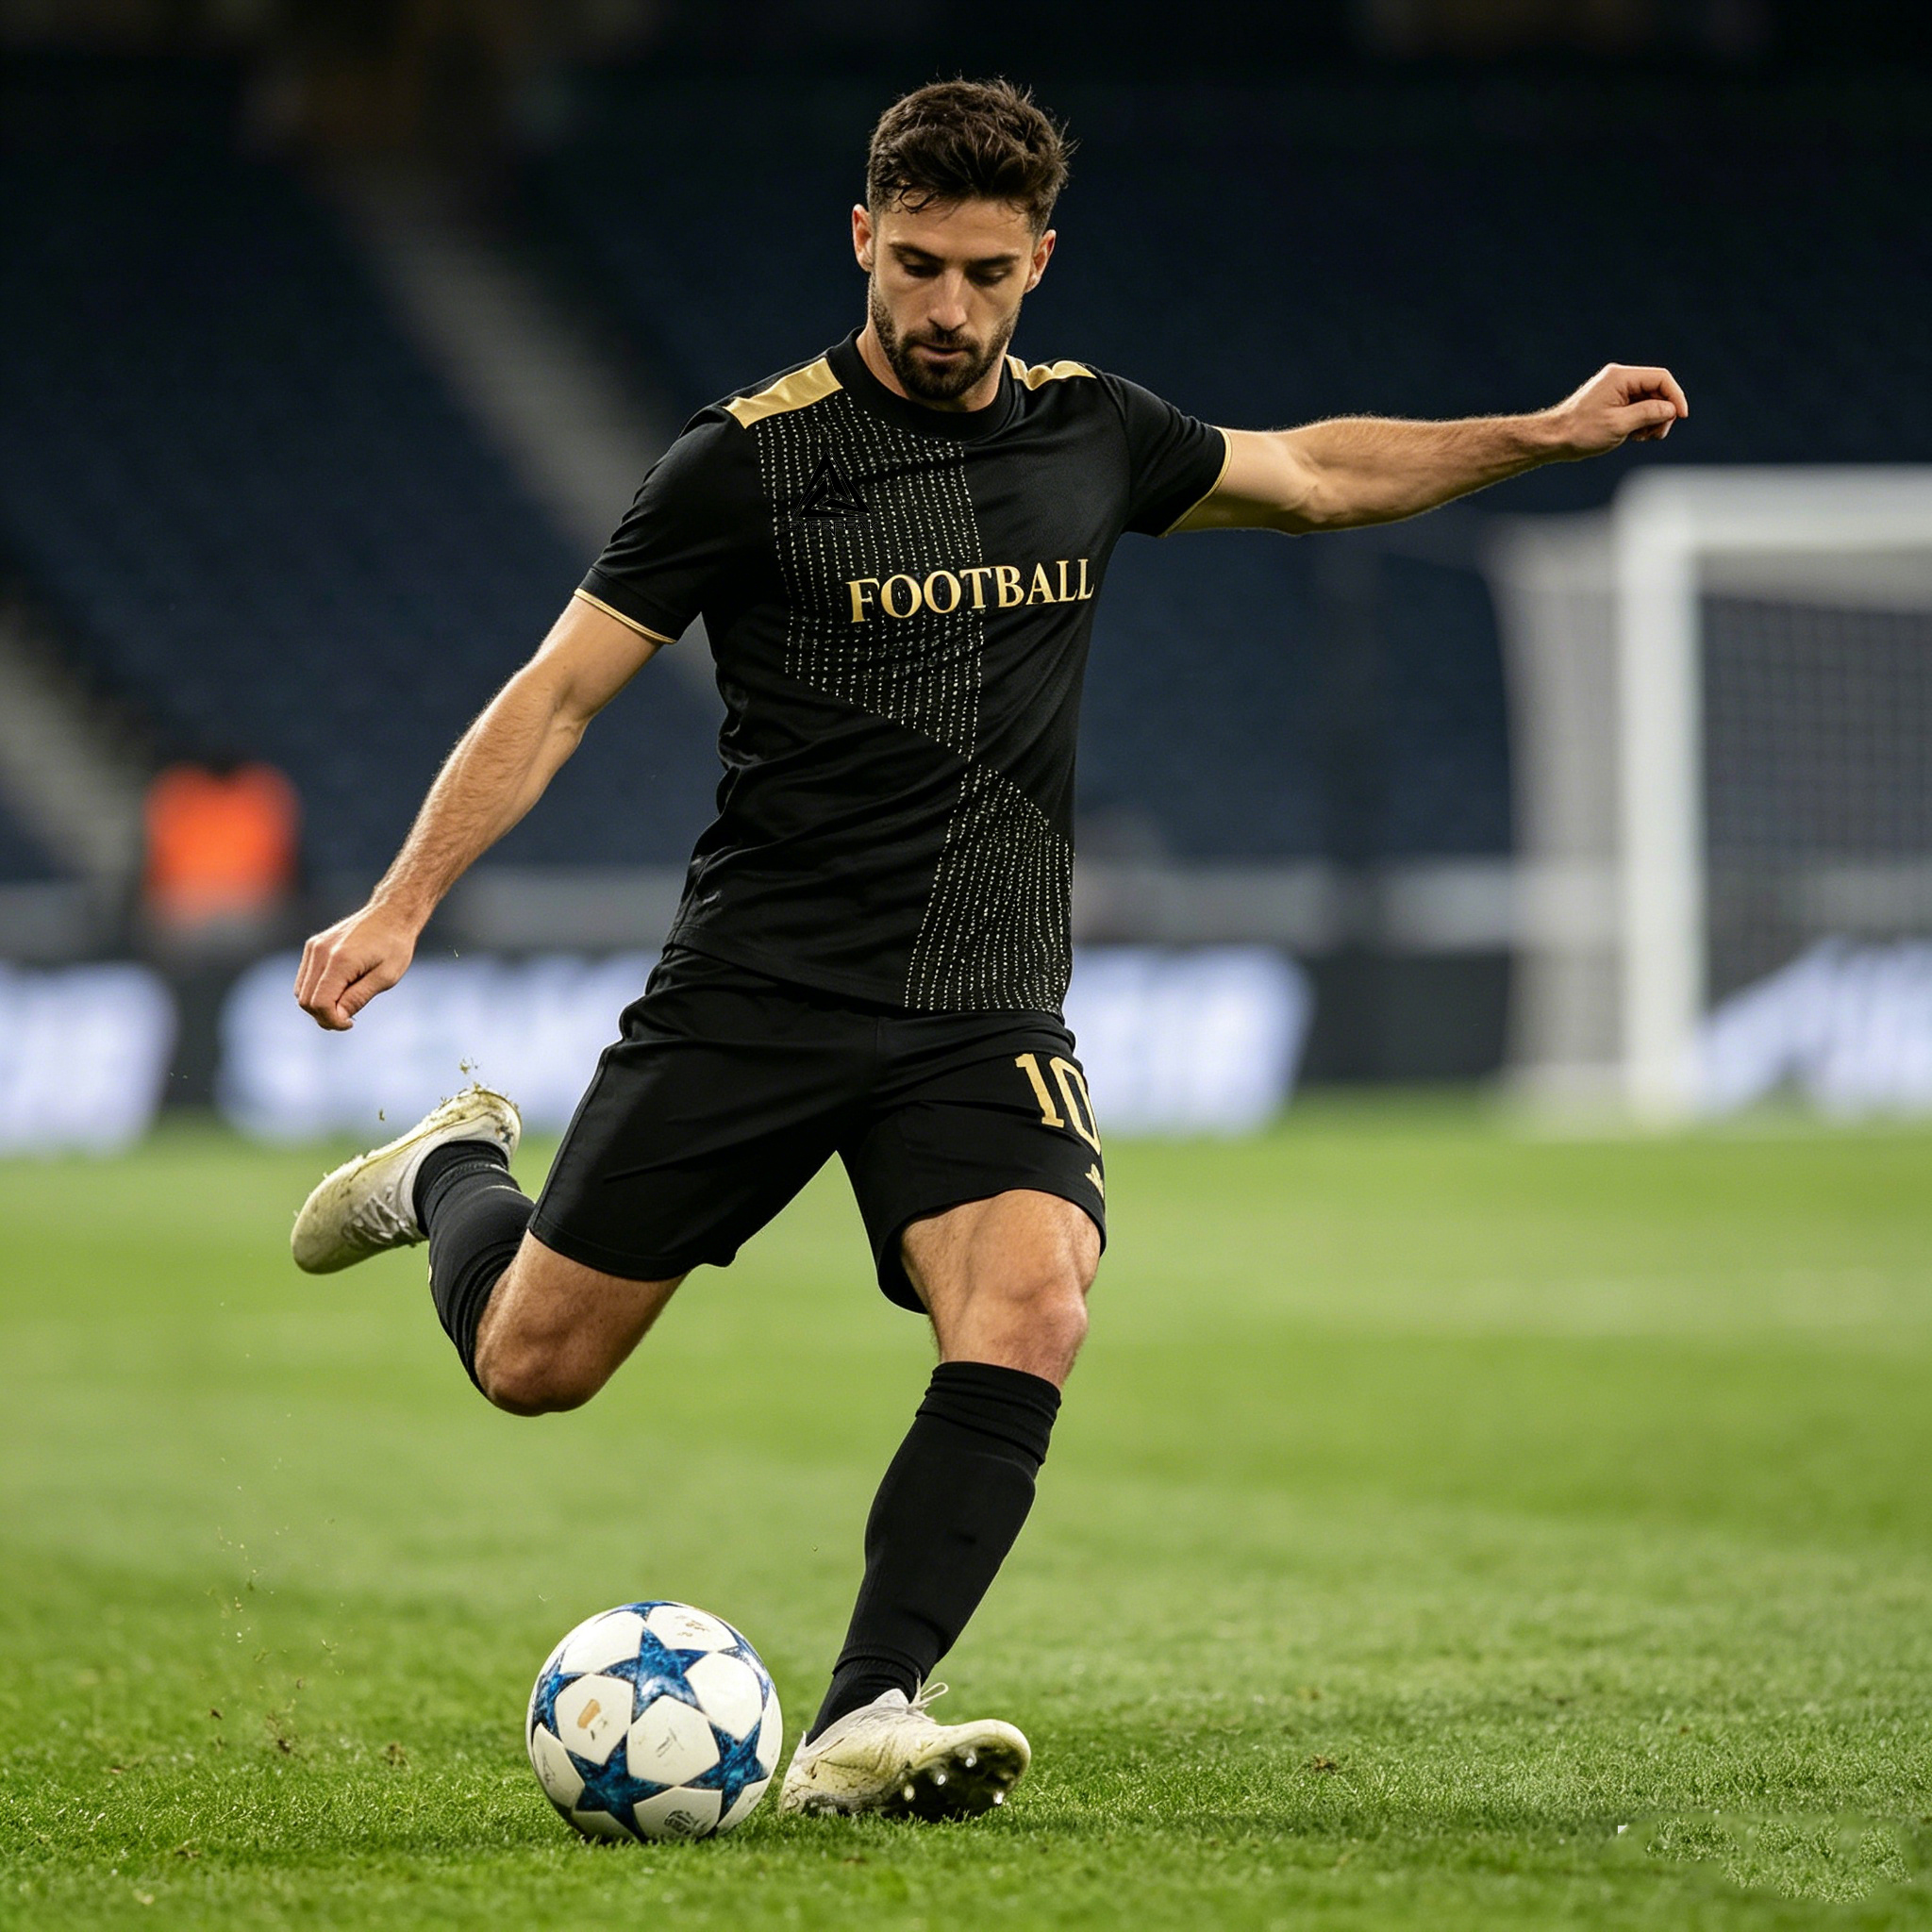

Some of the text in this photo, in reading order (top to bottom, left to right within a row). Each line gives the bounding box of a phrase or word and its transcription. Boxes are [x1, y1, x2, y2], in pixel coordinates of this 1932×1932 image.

[788, 521, 877, 535] EVERPEAK
[846, 558, 1094, 623] FOOTBALL
[1014, 1053, 1101, 1156] 10
